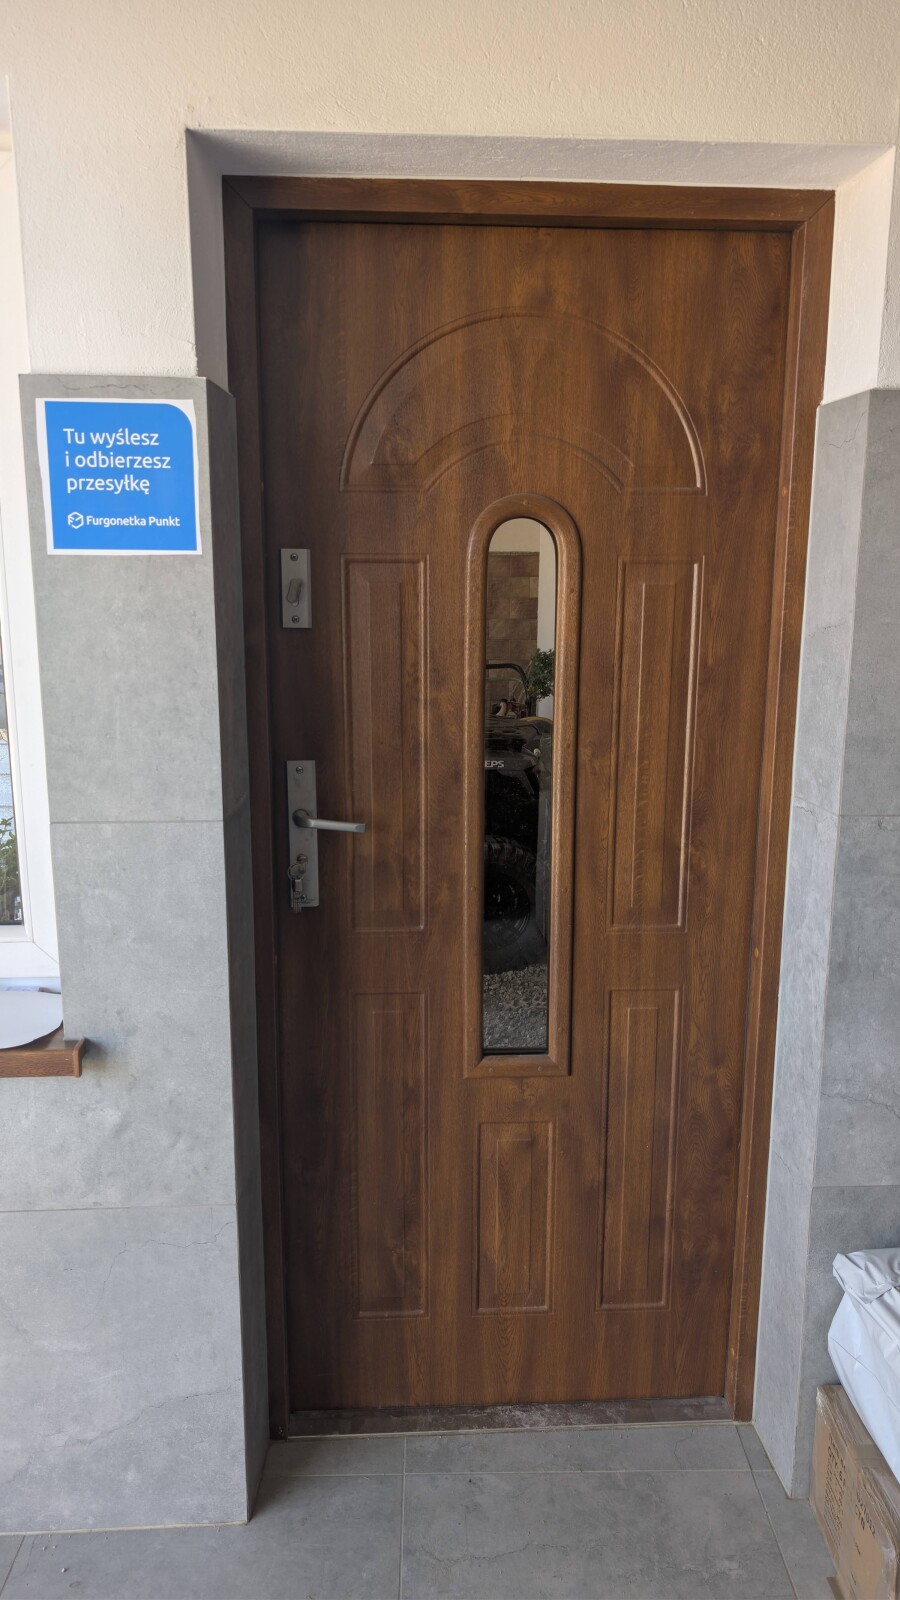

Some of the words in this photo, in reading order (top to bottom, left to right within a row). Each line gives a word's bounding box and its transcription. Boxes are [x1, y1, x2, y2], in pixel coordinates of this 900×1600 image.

[63, 428, 85, 444] Tu
[90, 428, 159, 448] wyślesz
[65, 451, 70, 467] i
[75, 451, 171, 469] odbierzesz
[66, 474, 150, 495] przesyłkę
[86, 515, 147, 528] Furgonetka
[149, 516, 181, 527] Punkt
[484, 760, 505, 768] EPS
